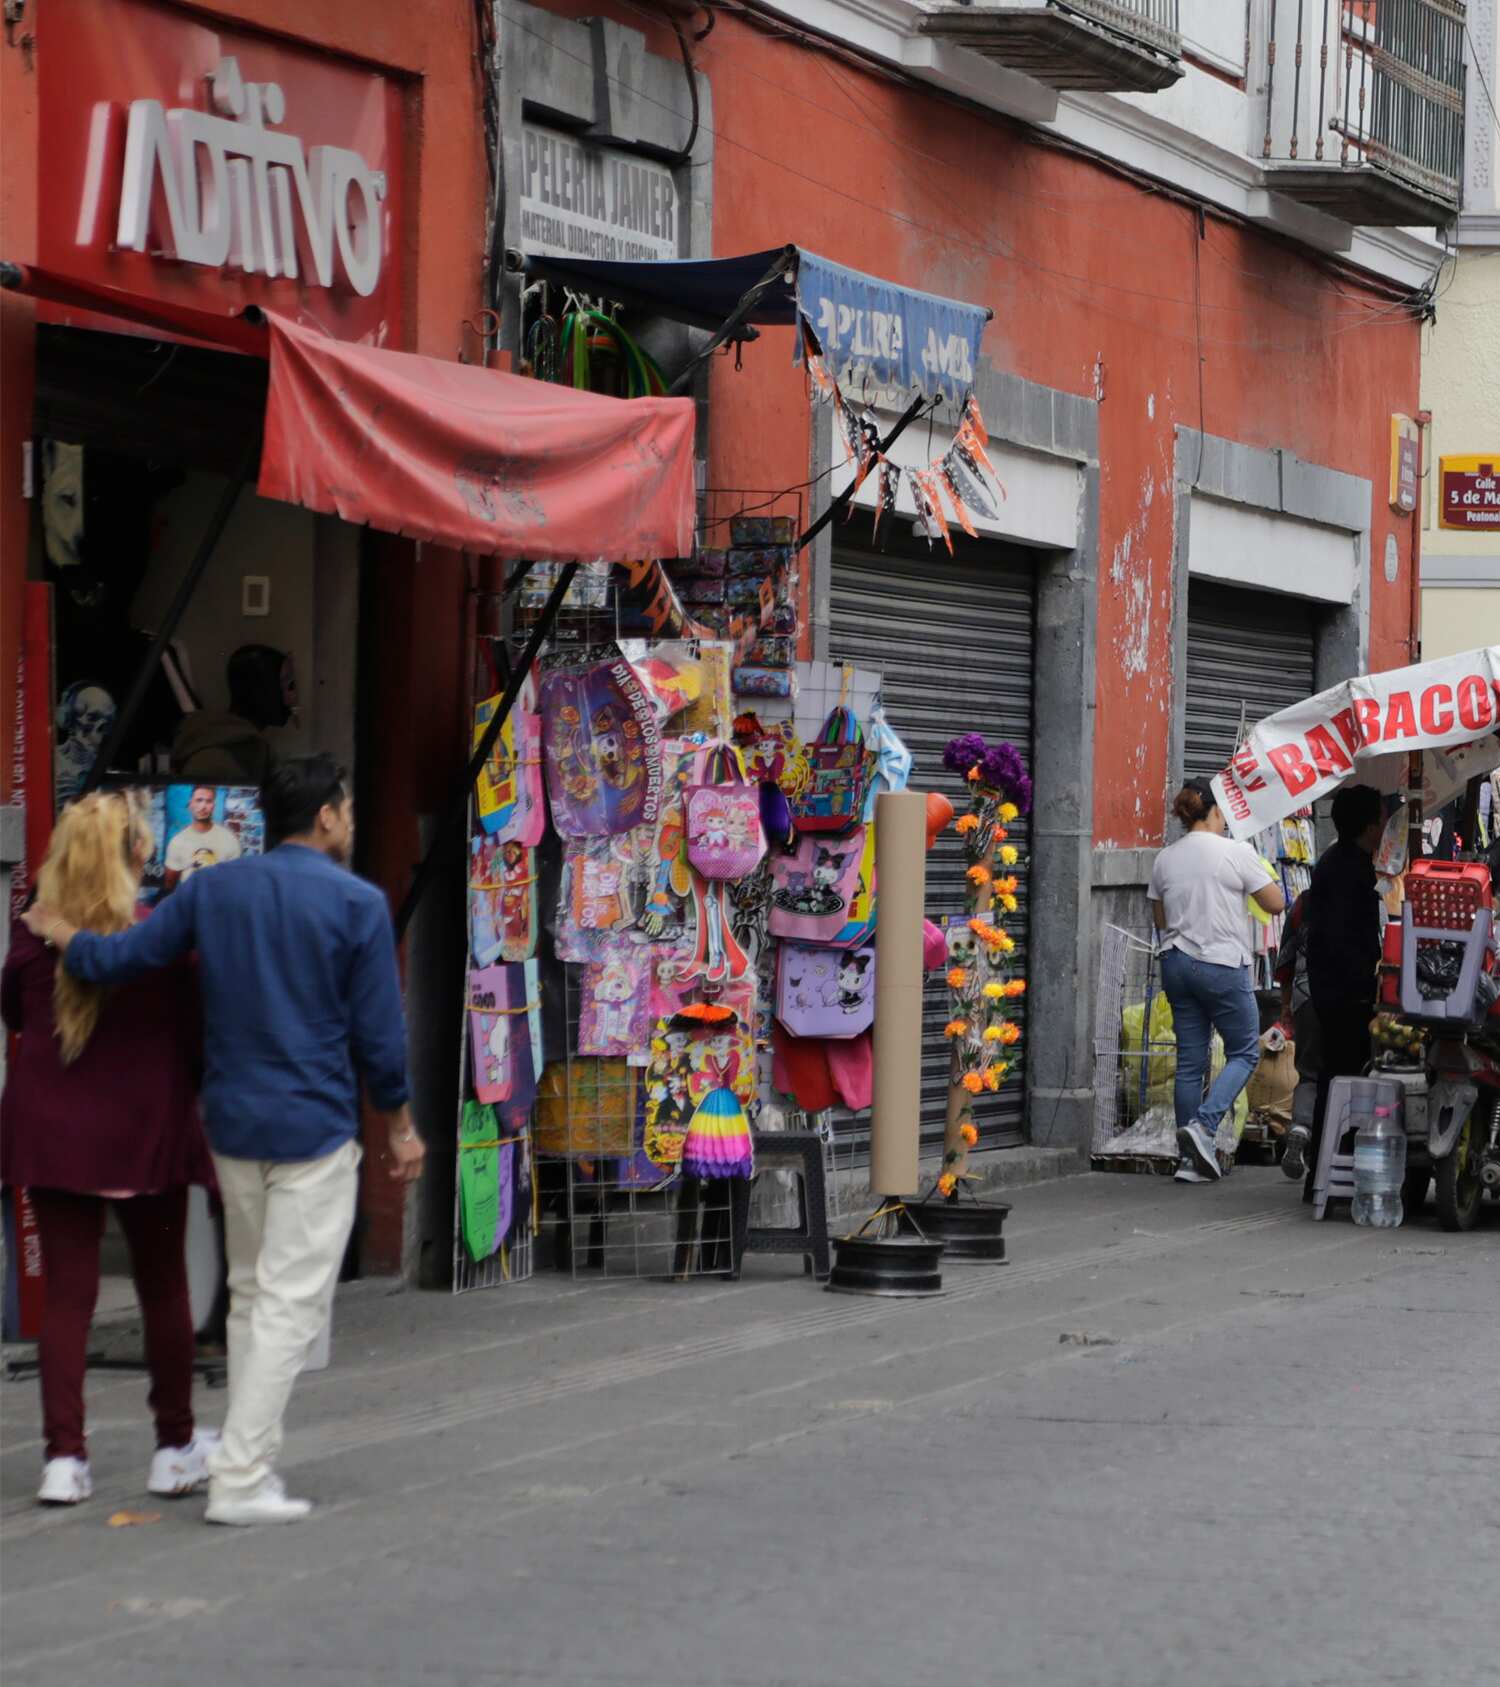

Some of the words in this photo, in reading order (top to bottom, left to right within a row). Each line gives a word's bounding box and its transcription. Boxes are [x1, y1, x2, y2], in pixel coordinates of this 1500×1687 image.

[611, 159, 675, 242] JAMER
[1475, 478, 1496, 489] Calle
[1450, 490, 1459, 504] 5
[1463, 490, 1480, 505] de
[628, 691, 648, 712] DE
[641, 719, 659, 745] LOS
[642, 755, 663, 822] MUERTOS
